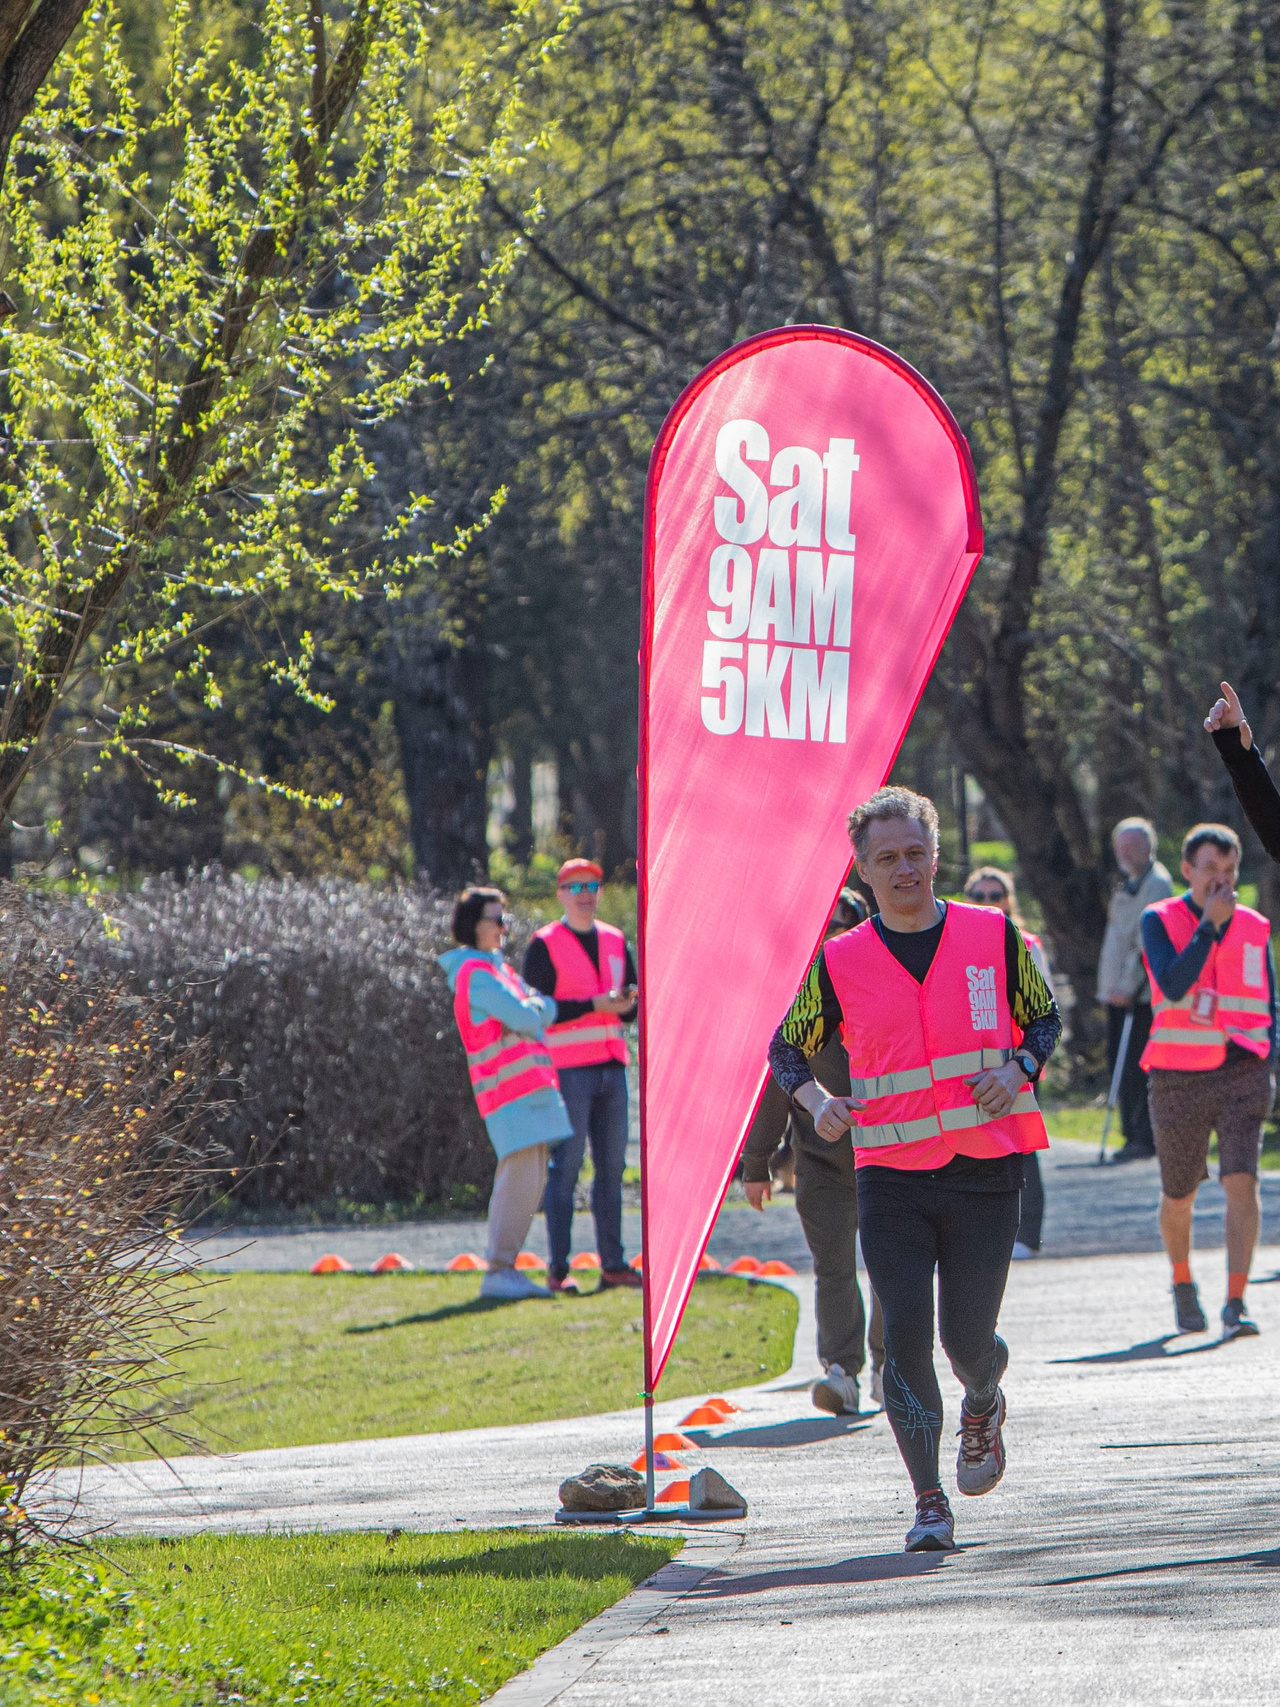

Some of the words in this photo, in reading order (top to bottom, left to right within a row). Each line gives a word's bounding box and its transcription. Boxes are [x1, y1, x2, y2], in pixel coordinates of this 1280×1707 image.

[714, 419, 860, 551] Sat
[706, 544, 855, 647] 9AM
[700, 640, 850, 743] 5KM
[966, 965, 995, 990] Sat
[969, 990, 996, 1010] 9AM
[971, 1010, 997, 1030] 5KM
